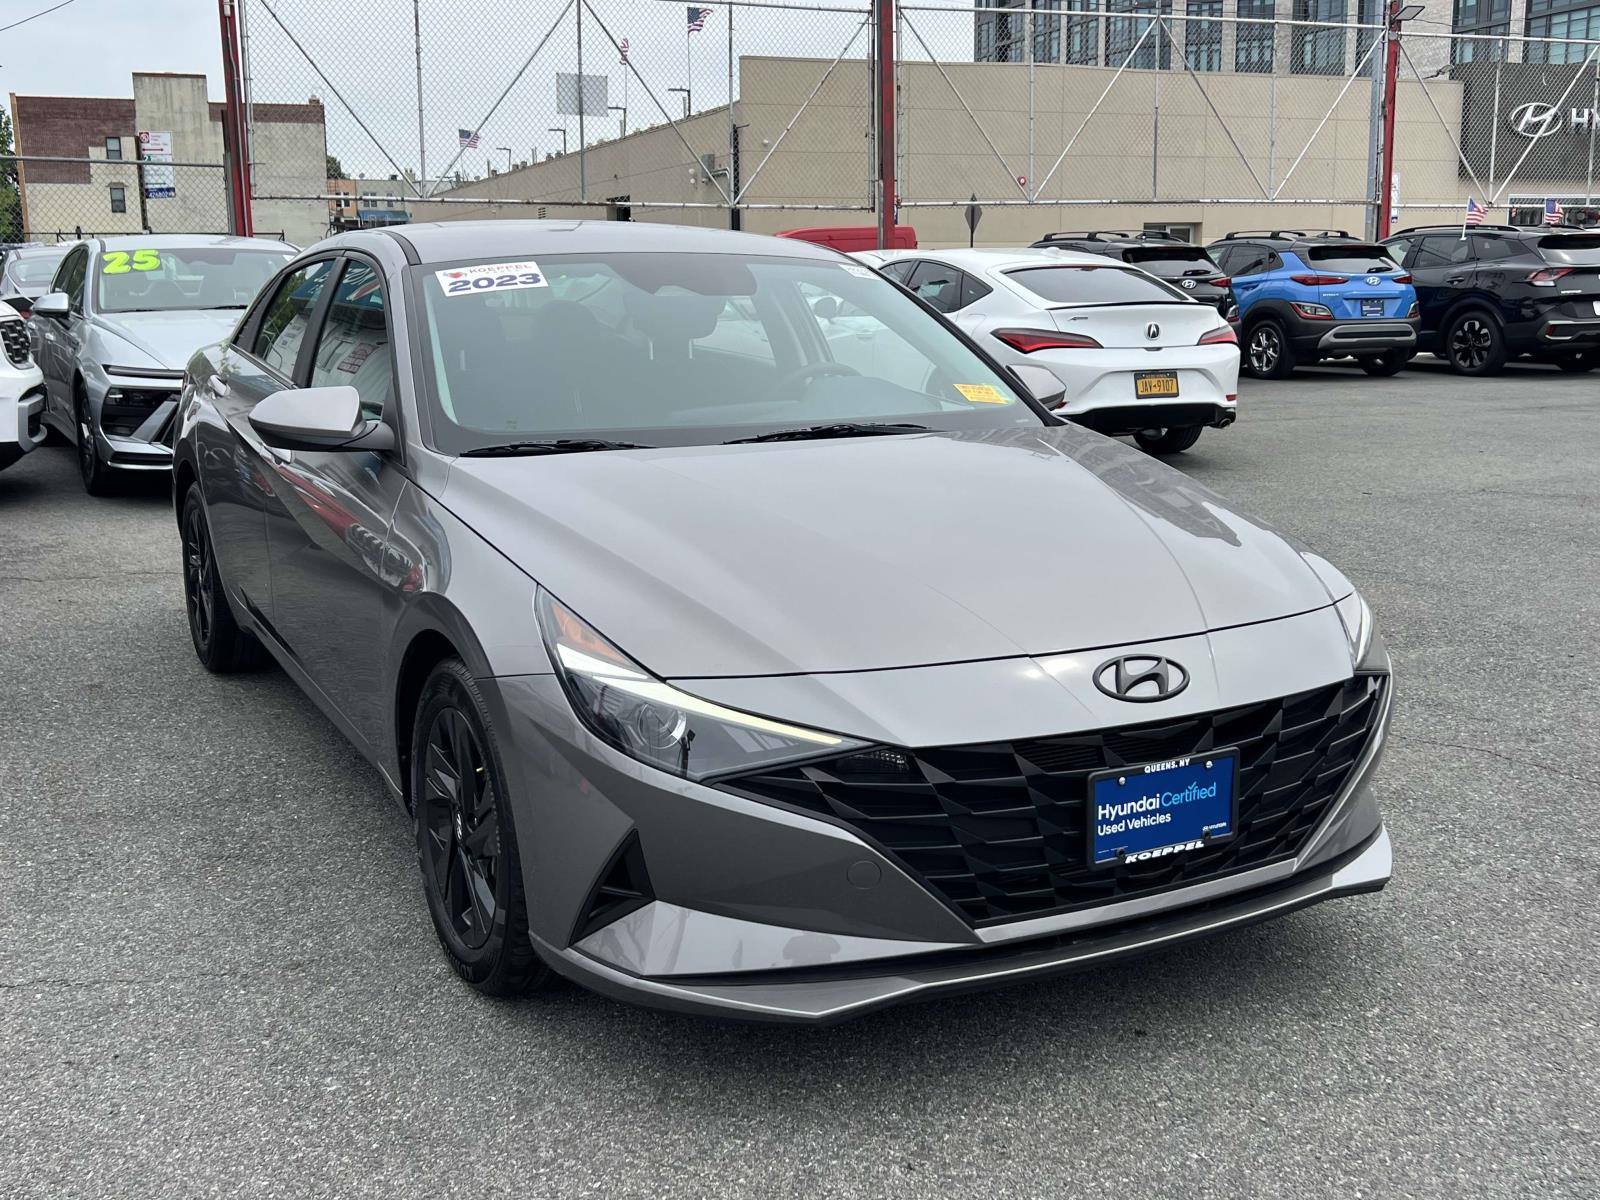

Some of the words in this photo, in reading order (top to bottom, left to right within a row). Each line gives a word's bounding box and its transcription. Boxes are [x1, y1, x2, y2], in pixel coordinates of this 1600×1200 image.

[103, 249, 161, 274] 25
[468, 264, 533, 274] KOEPPEL
[448, 272, 541, 293] 2023
[1179, 758, 1191, 768] NY
[1098, 794, 1160, 821] Hyundai
[1161, 782, 1217, 807] Certified
[1097, 820, 1126, 836] Used
[1127, 812, 1172, 830] Vehicles
[1125, 840, 1205, 864] KOEPPEL
